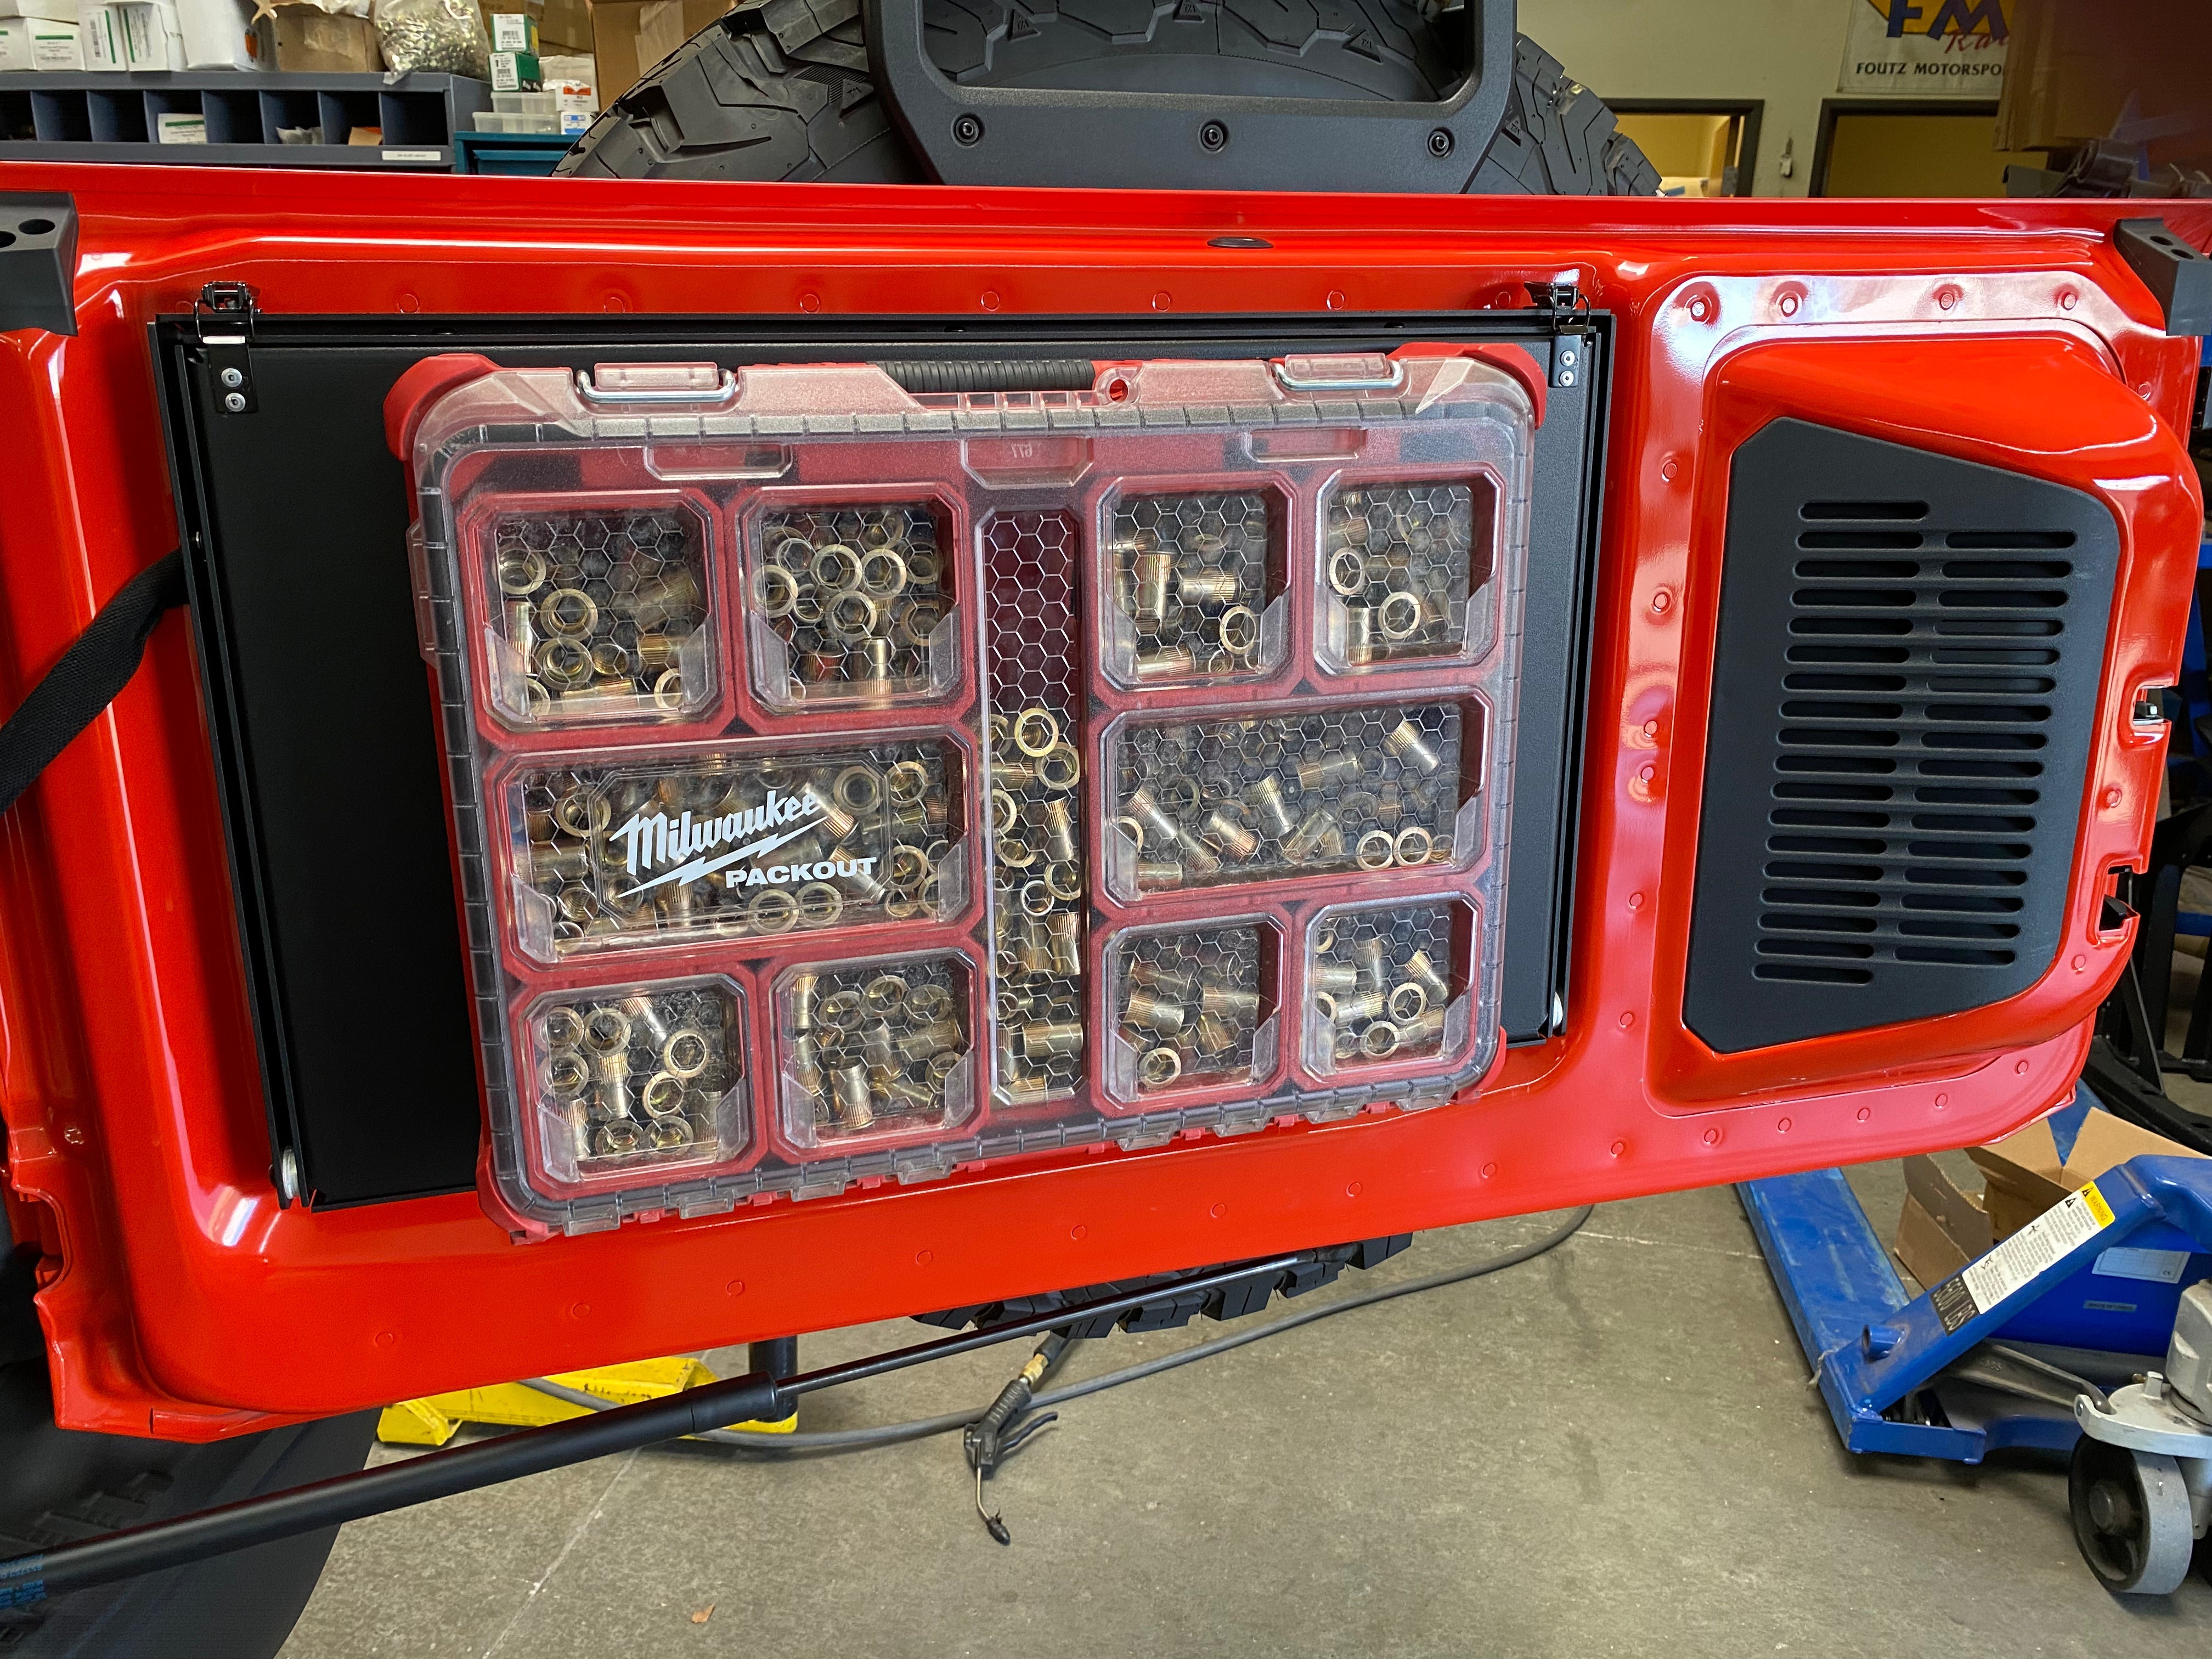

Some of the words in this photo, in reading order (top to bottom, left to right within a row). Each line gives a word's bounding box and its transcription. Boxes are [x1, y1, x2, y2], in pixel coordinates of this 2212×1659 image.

[1855, 62, 1908, 75] FOUTZ
[1914, 62, 2002, 76] MOTORSPO
[608, 790, 821, 876] Milwaukee
[725, 856, 877, 888] PACKOUT
[2089, 1194, 2108, 1221] WARNING
[1944, 1300, 1975, 1330] LBS
